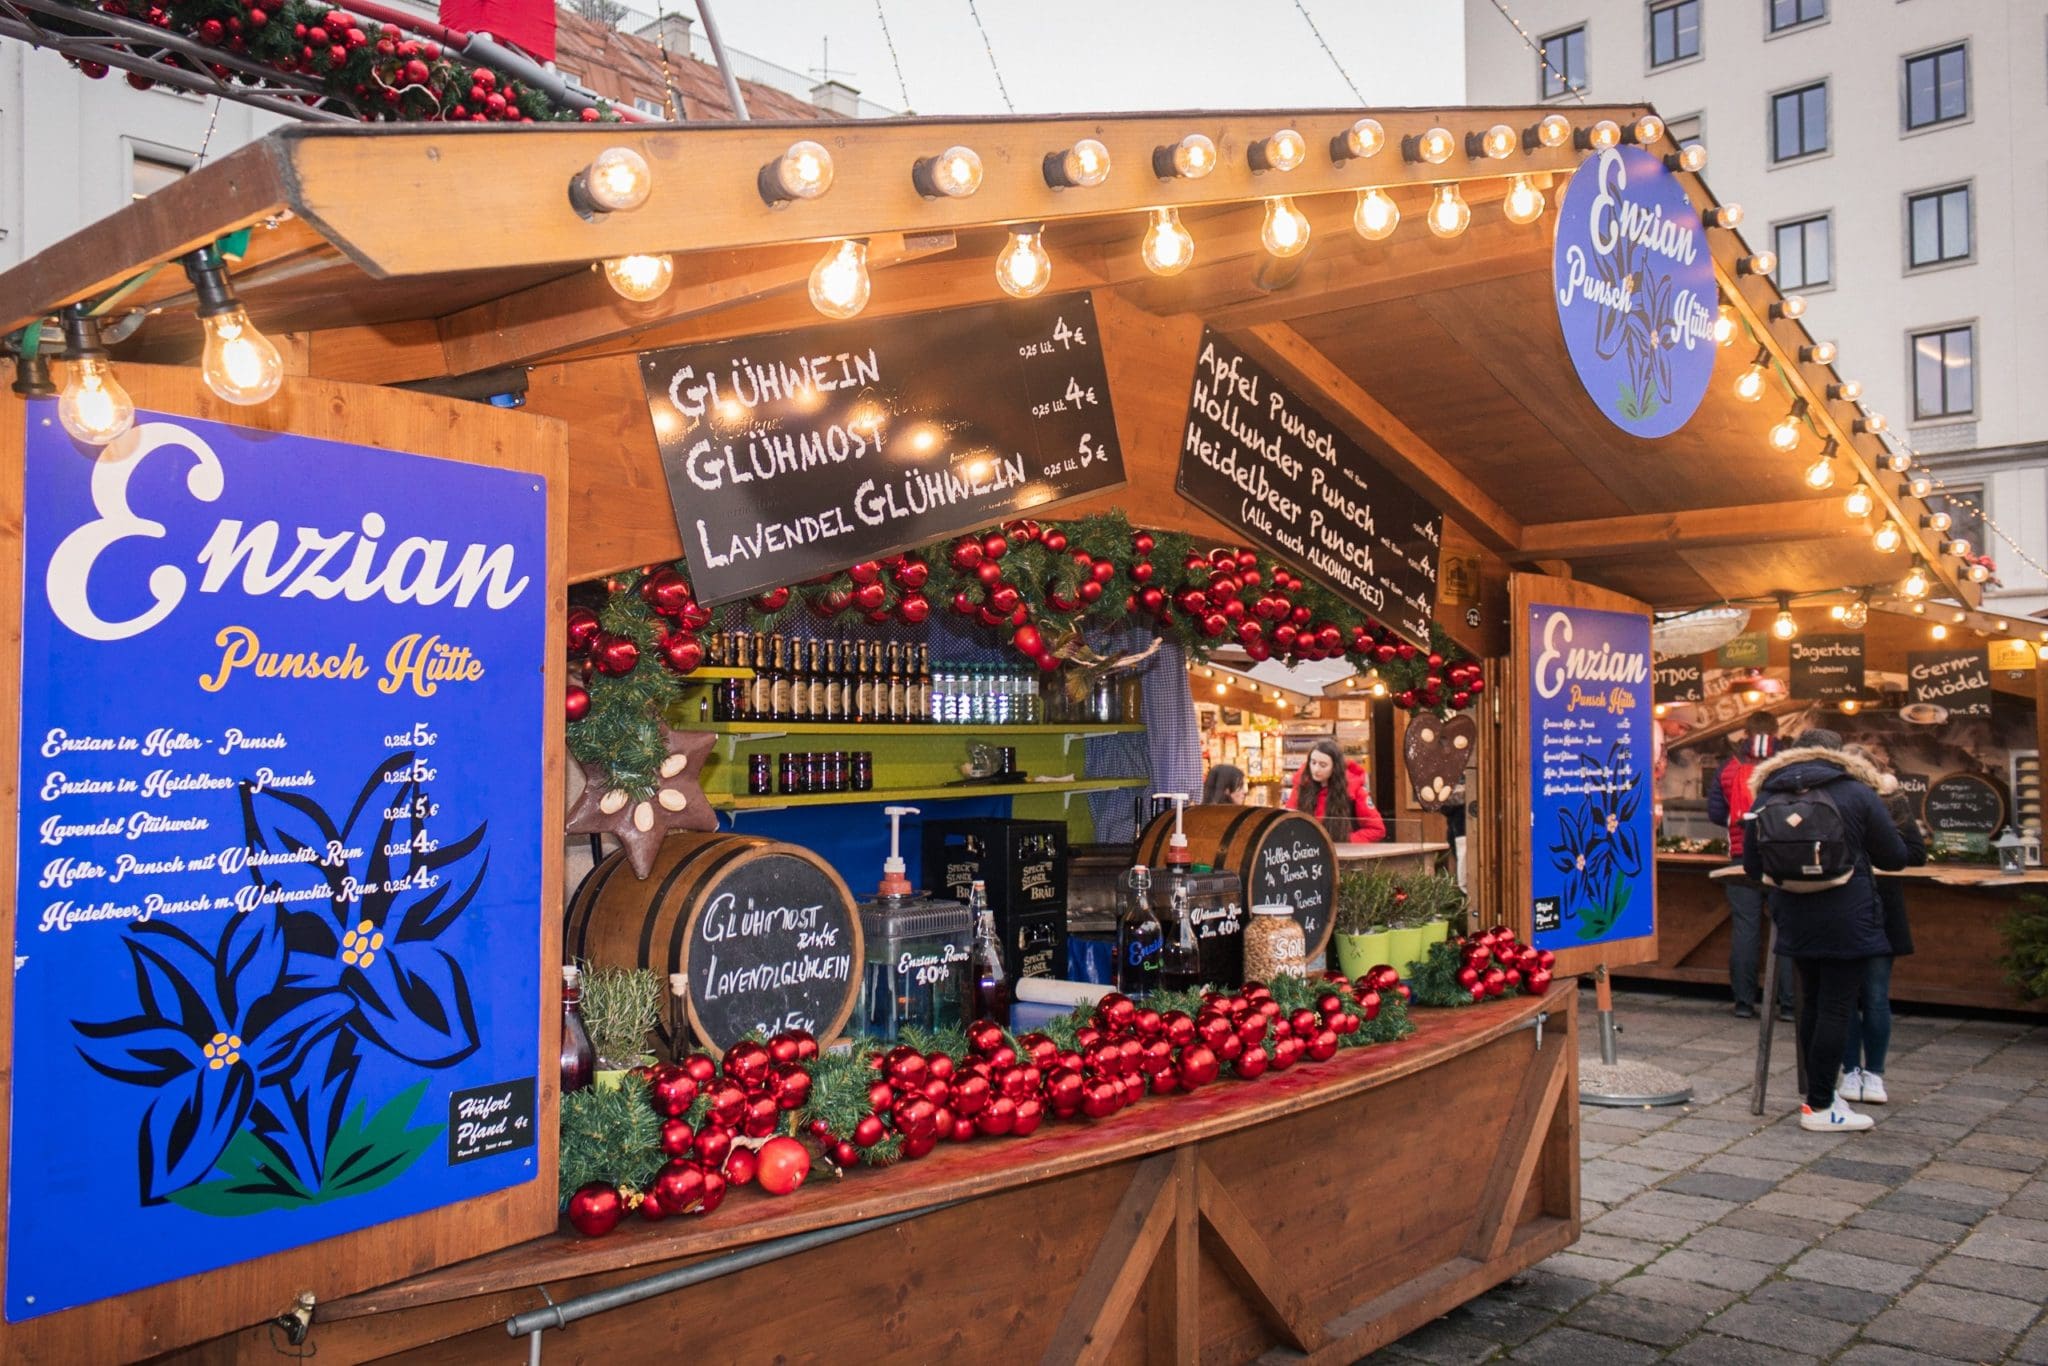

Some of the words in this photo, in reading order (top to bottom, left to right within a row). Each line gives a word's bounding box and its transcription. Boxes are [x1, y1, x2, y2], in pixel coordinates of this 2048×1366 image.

[1590, 148, 1696, 266] Enzian
[1560, 244, 1632, 314] Punsch
[1671, 289, 1714, 351] Hütte
[669, 348, 880, 417] GLÜHWEIN
[1199, 342, 1259, 406] Apfel
[1270, 392, 1337, 466] Punsch
[686, 415, 885, 490] GLÜHMOST
[1193, 379, 1303, 482] Hollunder
[1311, 468, 1375, 537] Punsch
[696, 507, 855, 569] LAVENDEL
[854, 452, 1026, 526] GLÜHWEIN
[1187, 422, 1301, 525] Heidelbeer
[1310, 509, 1375, 577] Punsch
[46, 422, 530, 640] Enzian
[1276, 529, 1304, 556] auch
[199, 626, 368, 692] Punsch
[378, 634, 484, 697] Hütte
[1535, 611, 1648, 699] Enzian
[1911, 656, 1979, 680] Germ-
[1567, 684, 1606, 712] Punsch
[1608, 687, 1636, 715] Hütte
[1917, 671, 1989, 701] Knödel
[41, 728, 115, 758] Enzian
[115, 737, 139, 751] in
[141, 728, 203, 757] Holler
[218, 728, 287, 755] Punsch
[40, 771, 114, 801] Enzian
[117, 778, 138, 792] in
[141, 769, 234, 798] Heidelbeer
[250, 767, 315, 794] Punsch
[40, 815, 126, 846] Lavendel
[126, 811, 209, 840] Glühwein
[39, 857, 106, 888] Holler
[109, 854, 185, 883] Punsch
[188, 853, 216, 871] mit
[218, 846, 319, 874] Weihnachts
[321, 840, 363, 867] Rum
[38, 901, 140, 932] Heidelbeer
[138, 893, 211, 922] Punsch
[234, 882, 334, 913] Weihnachts
[336, 876, 378, 903] Rum
[898, 952, 939, 974] Enzian
[916, 964, 949, 986] 40%
[457, 1116, 507, 1146] Pfand
[458, 1091, 512, 1119] Häferl
